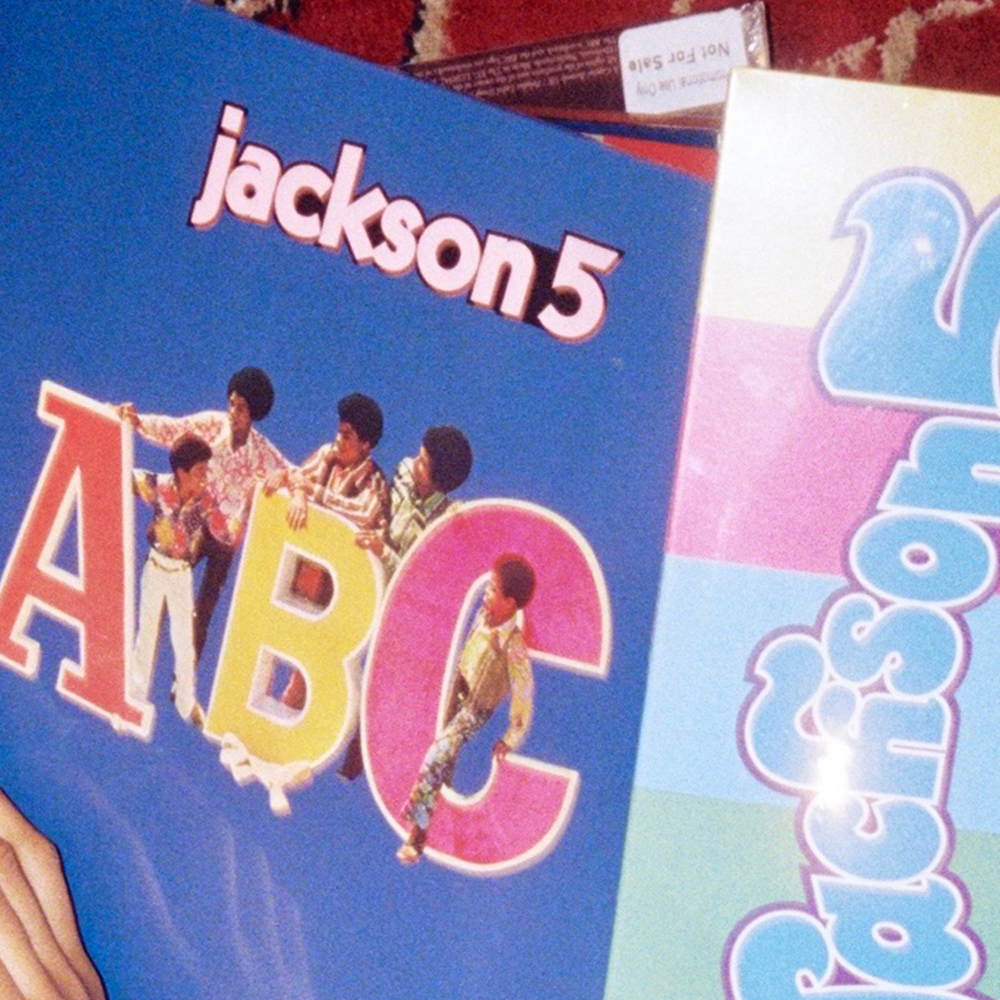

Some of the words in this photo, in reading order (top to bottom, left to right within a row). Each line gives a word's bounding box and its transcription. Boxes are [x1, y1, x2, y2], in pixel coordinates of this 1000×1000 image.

[667, 47, 696, 65] For
[700, 41, 730, 59] Not
[627, 53, 663, 74] Sale
[187, 101, 537, 322] jackson
[536, 230, 626, 345] 5
